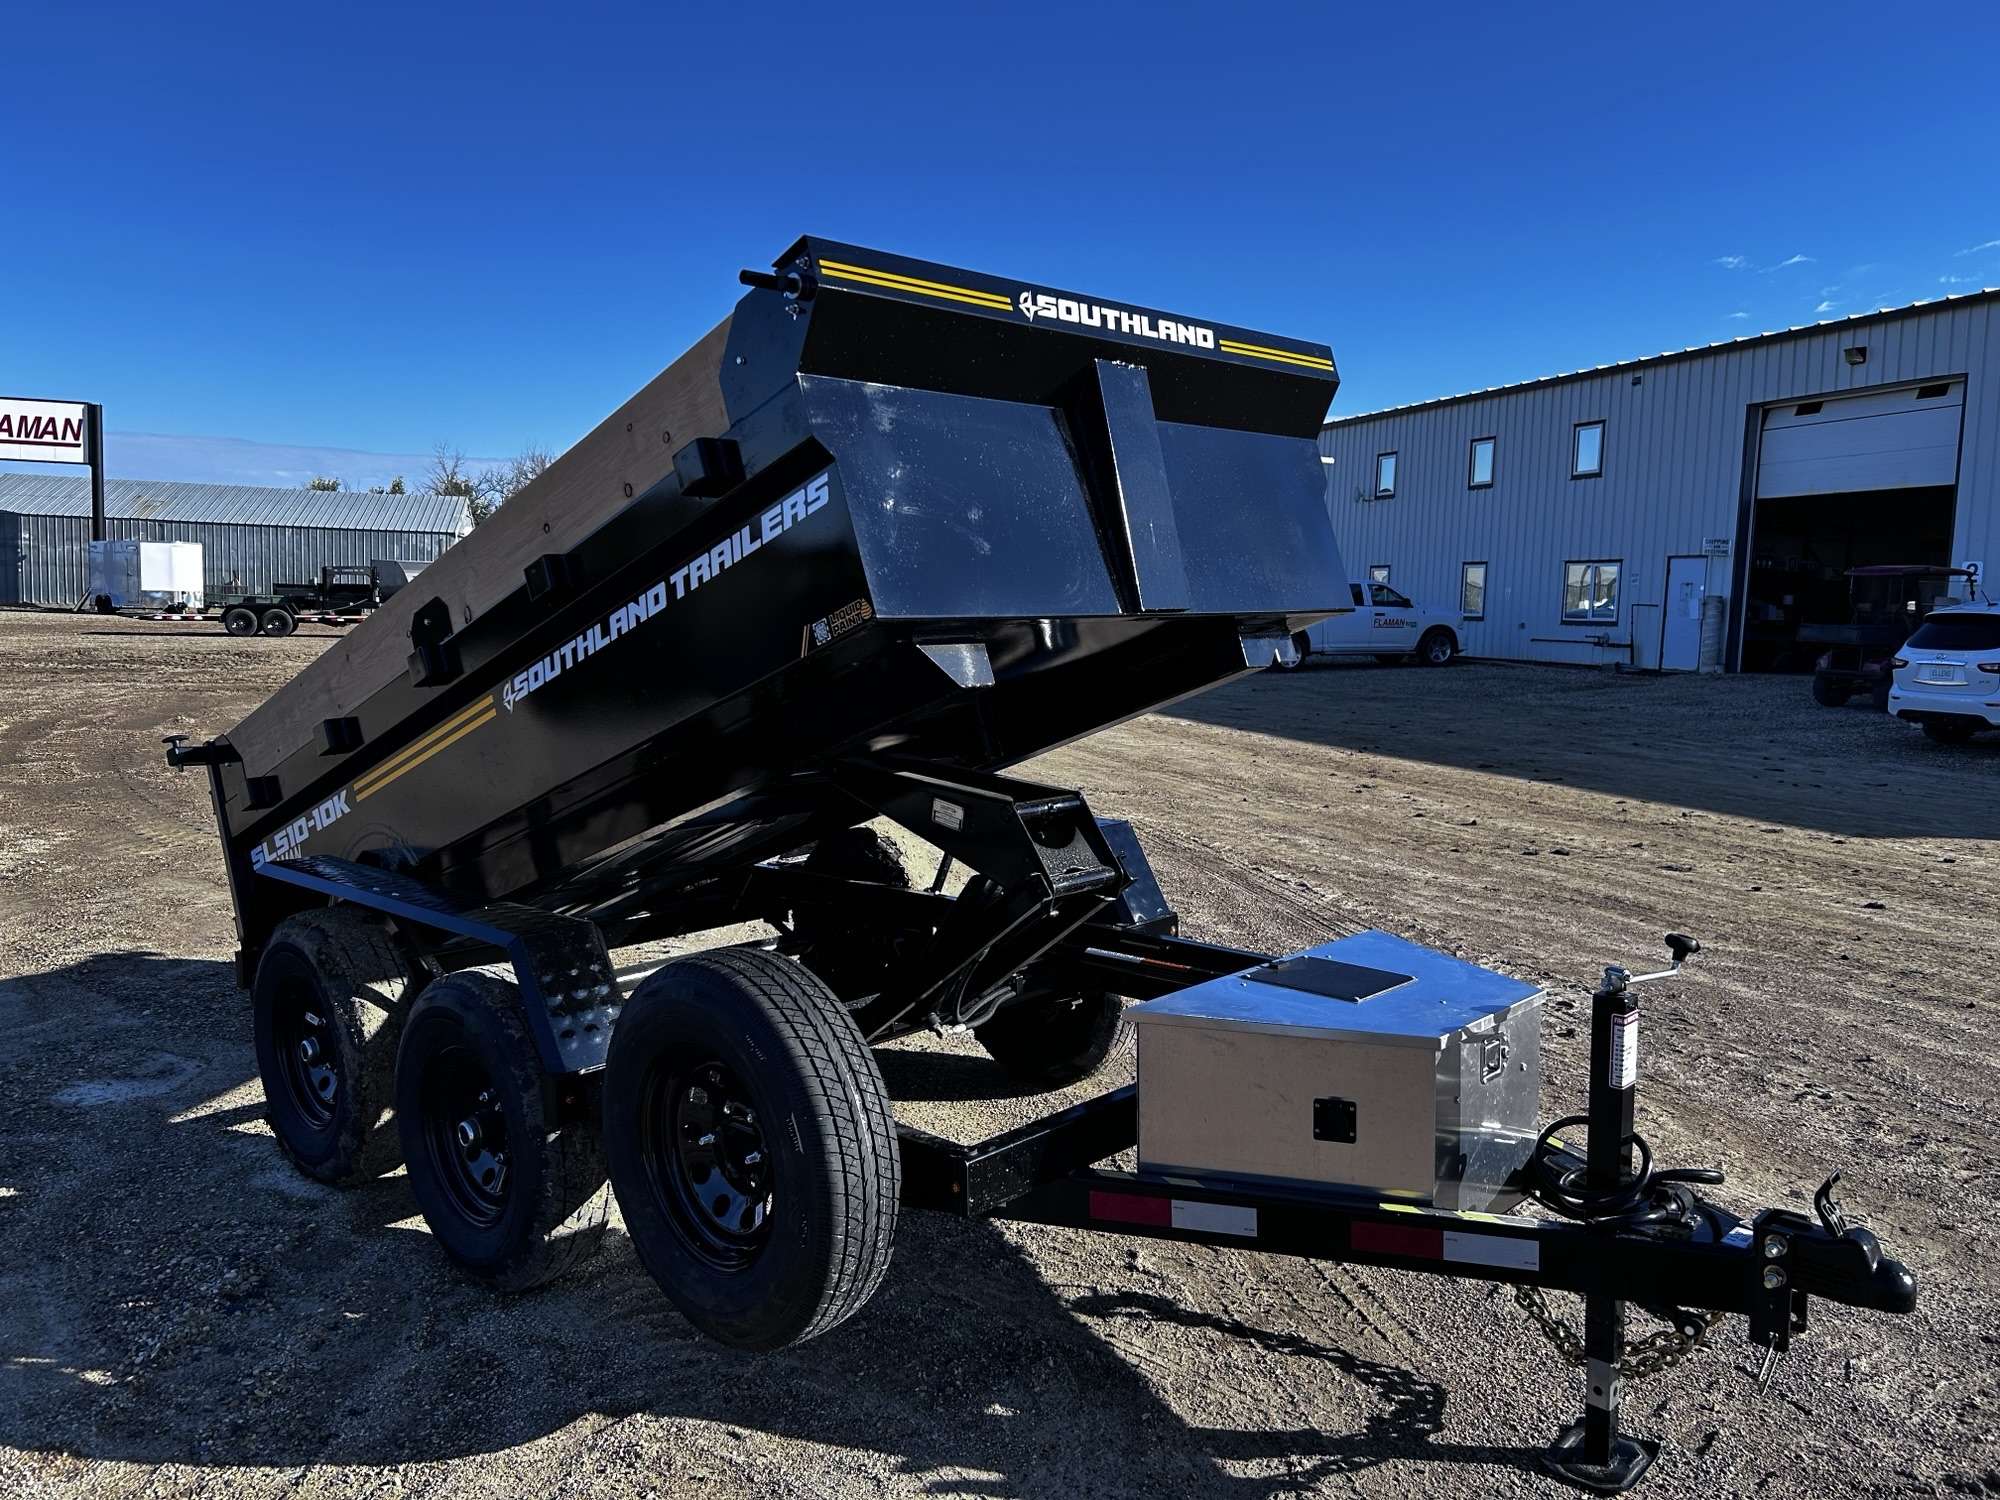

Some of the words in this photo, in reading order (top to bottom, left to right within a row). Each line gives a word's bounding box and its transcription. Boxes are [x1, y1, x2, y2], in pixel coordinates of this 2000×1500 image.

[1036, 294, 1215, 349] SOUTHLAND
[0, 414, 83, 441] AMAN
[513, 581, 668, 701] SOUTHLAND
[670, 472, 829, 600] TRAILERS
[832, 612, 862, 636] PAINT
[1374, 618, 1407, 628] FLAMAN
